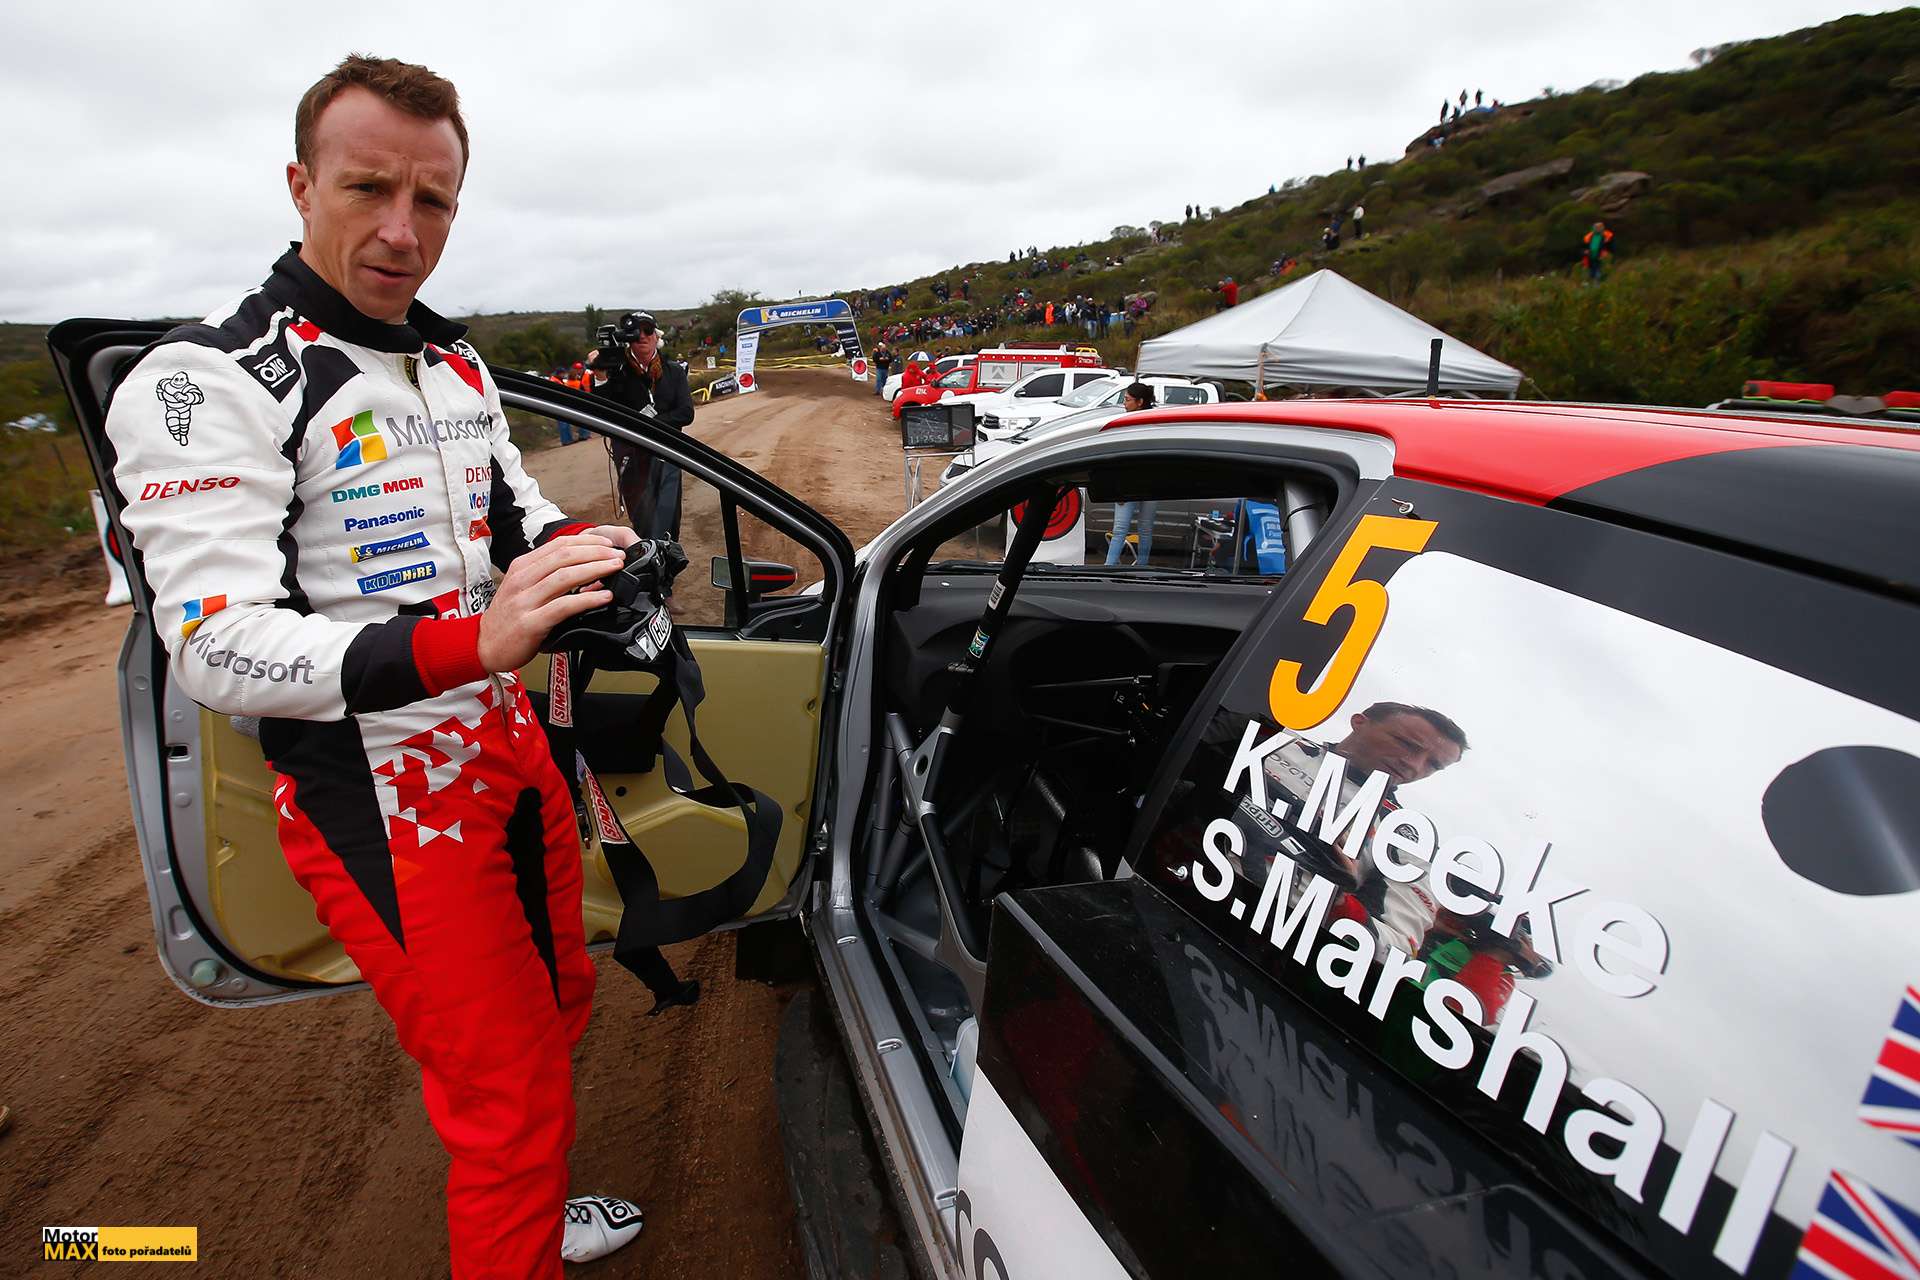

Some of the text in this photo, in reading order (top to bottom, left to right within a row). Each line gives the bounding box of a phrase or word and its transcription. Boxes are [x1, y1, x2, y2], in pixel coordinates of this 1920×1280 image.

[780, 307, 821, 318] MICHELIN
[259, 357, 293, 382] OMP
[140, 476, 241, 501] DENSO
[331, 477, 424, 503] DMG MORI
[344, 506, 425, 532] Panasonic
[376, 536, 424, 554] MICHELIN
[1269, 514, 1440, 732] 5
[189, 629, 315, 685] Microsoft
[554, 656, 566, 720] SIMPSON
[1222, 719, 1671, 1000] K.Meeke
[1191, 816, 1796, 1277] S.Marshall
